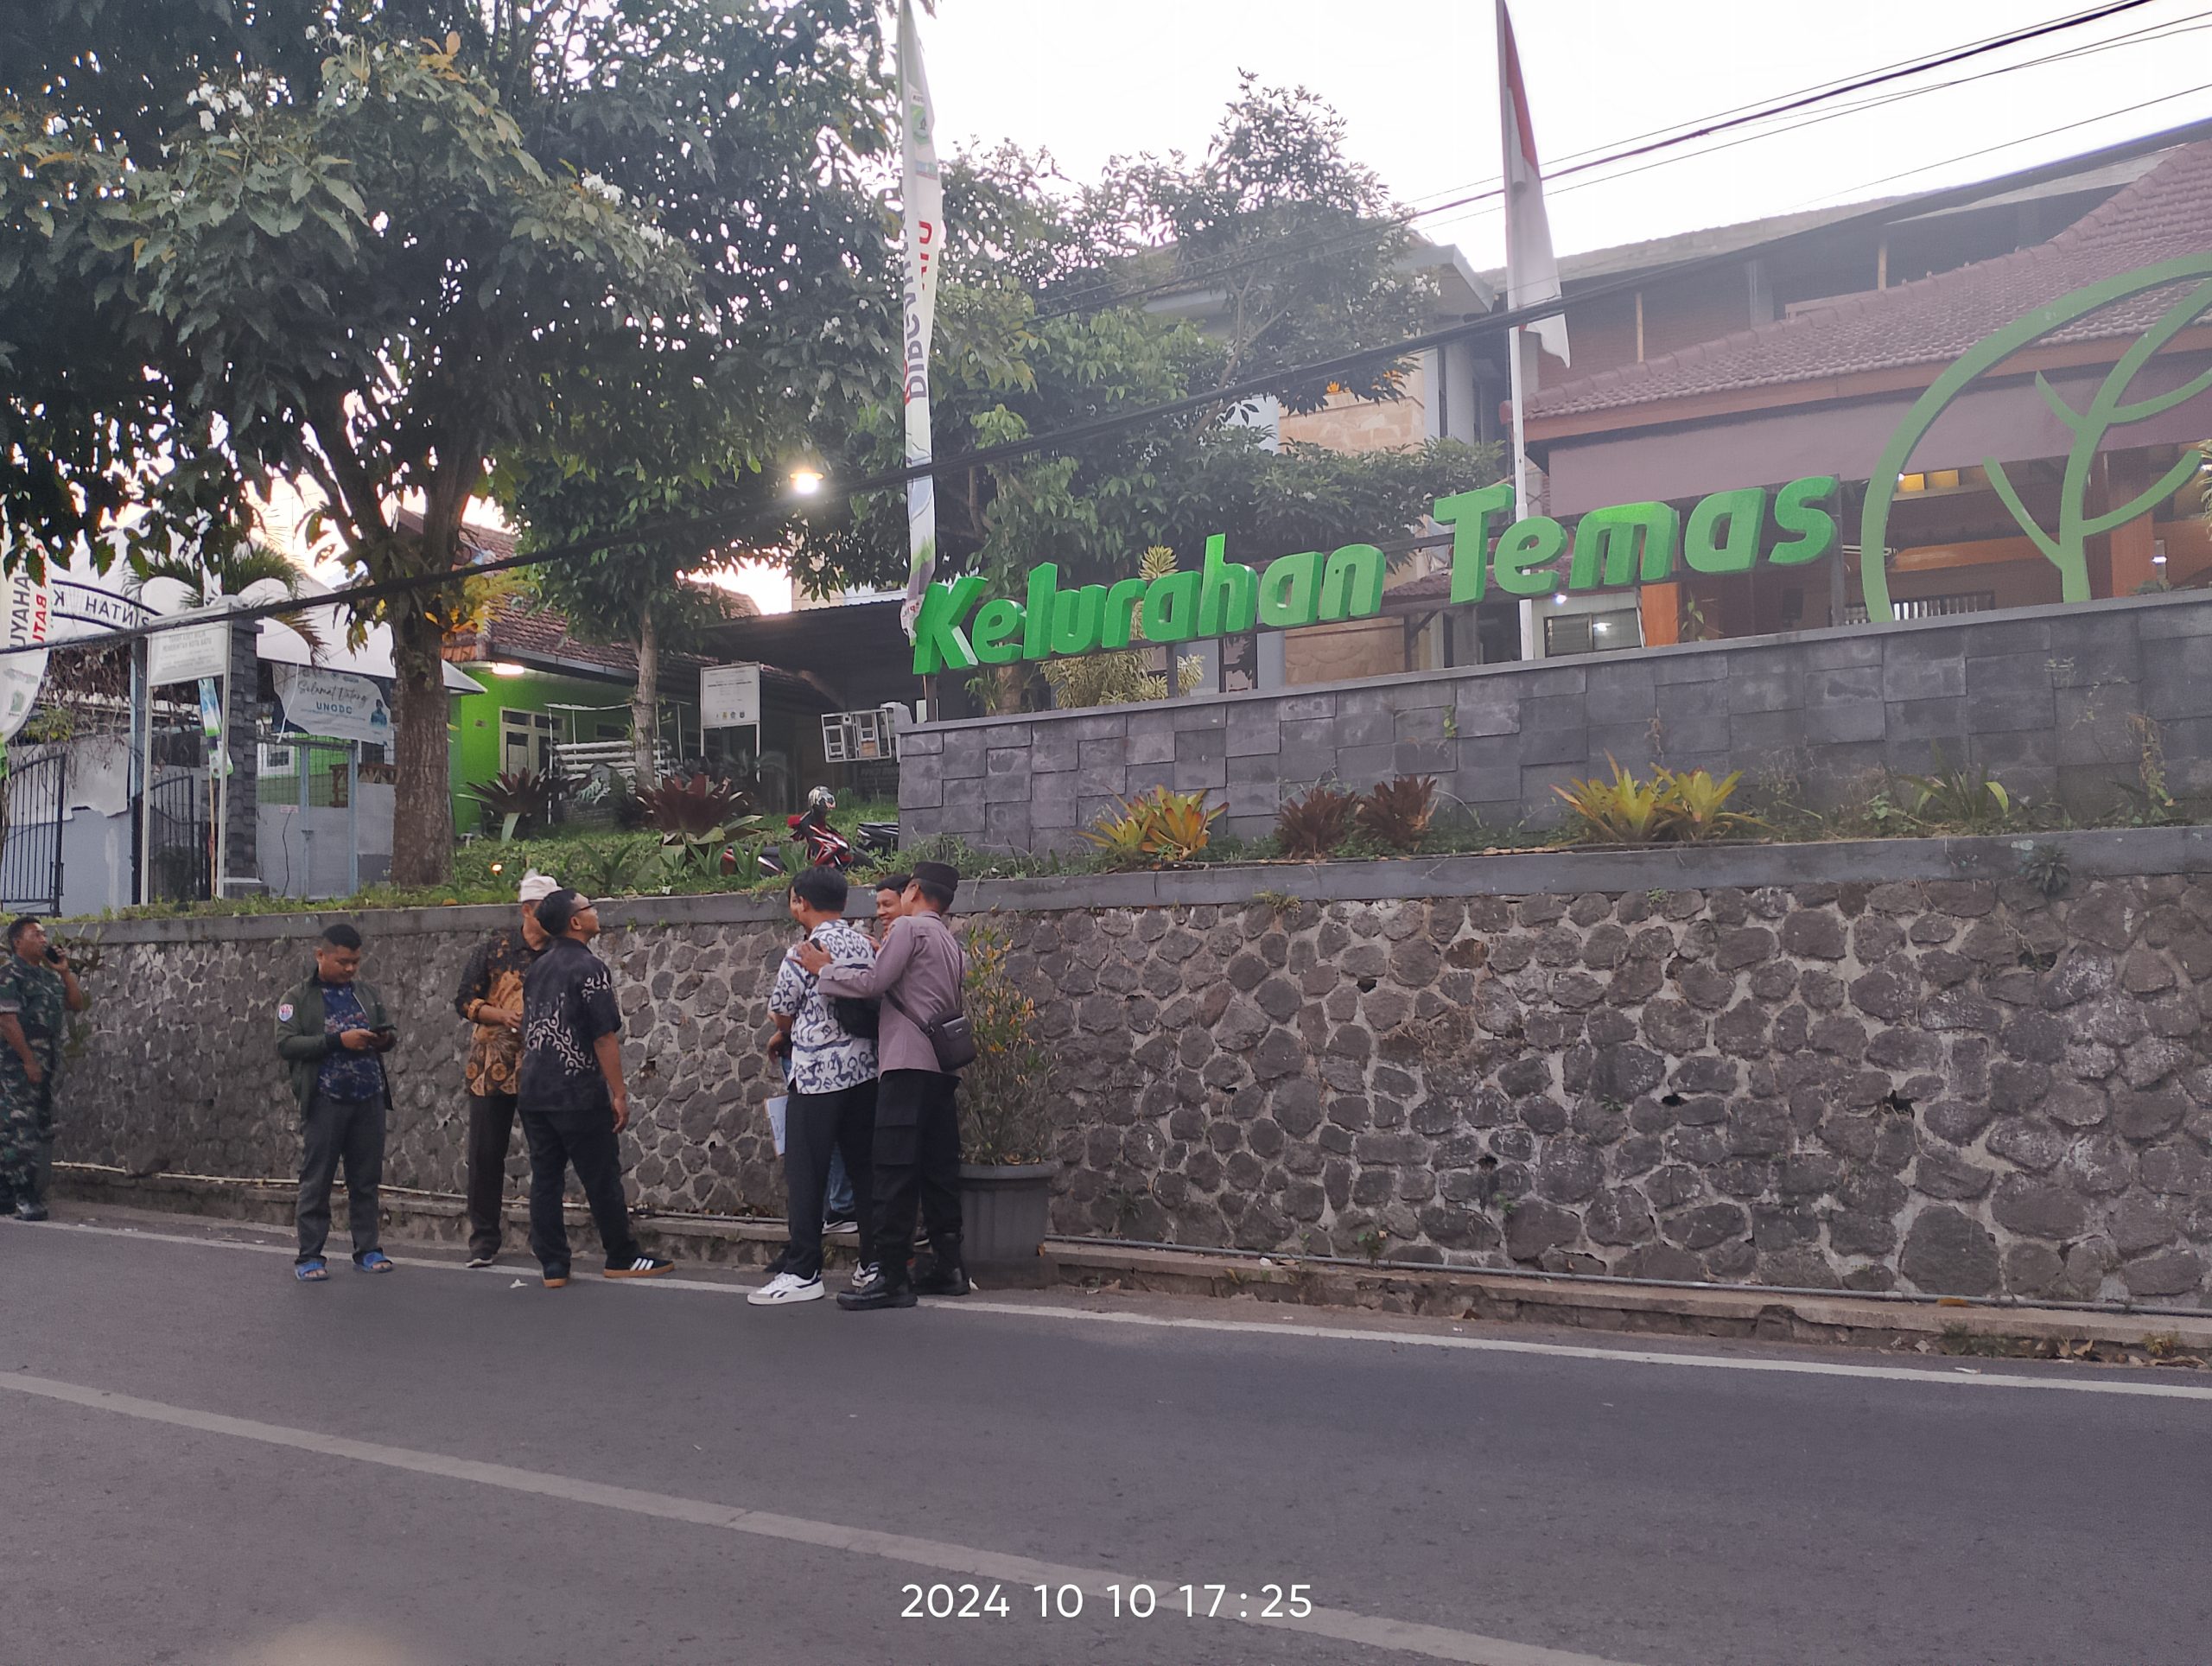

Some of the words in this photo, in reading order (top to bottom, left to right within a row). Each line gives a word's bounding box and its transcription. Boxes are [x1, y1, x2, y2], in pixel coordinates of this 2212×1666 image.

[912, 533, 1385, 675] Kelurahan
[1433, 475, 1839, 604] Temas
[297, 680, 336, 701] Selamat
[316, 701, 353, 714] UNODC
